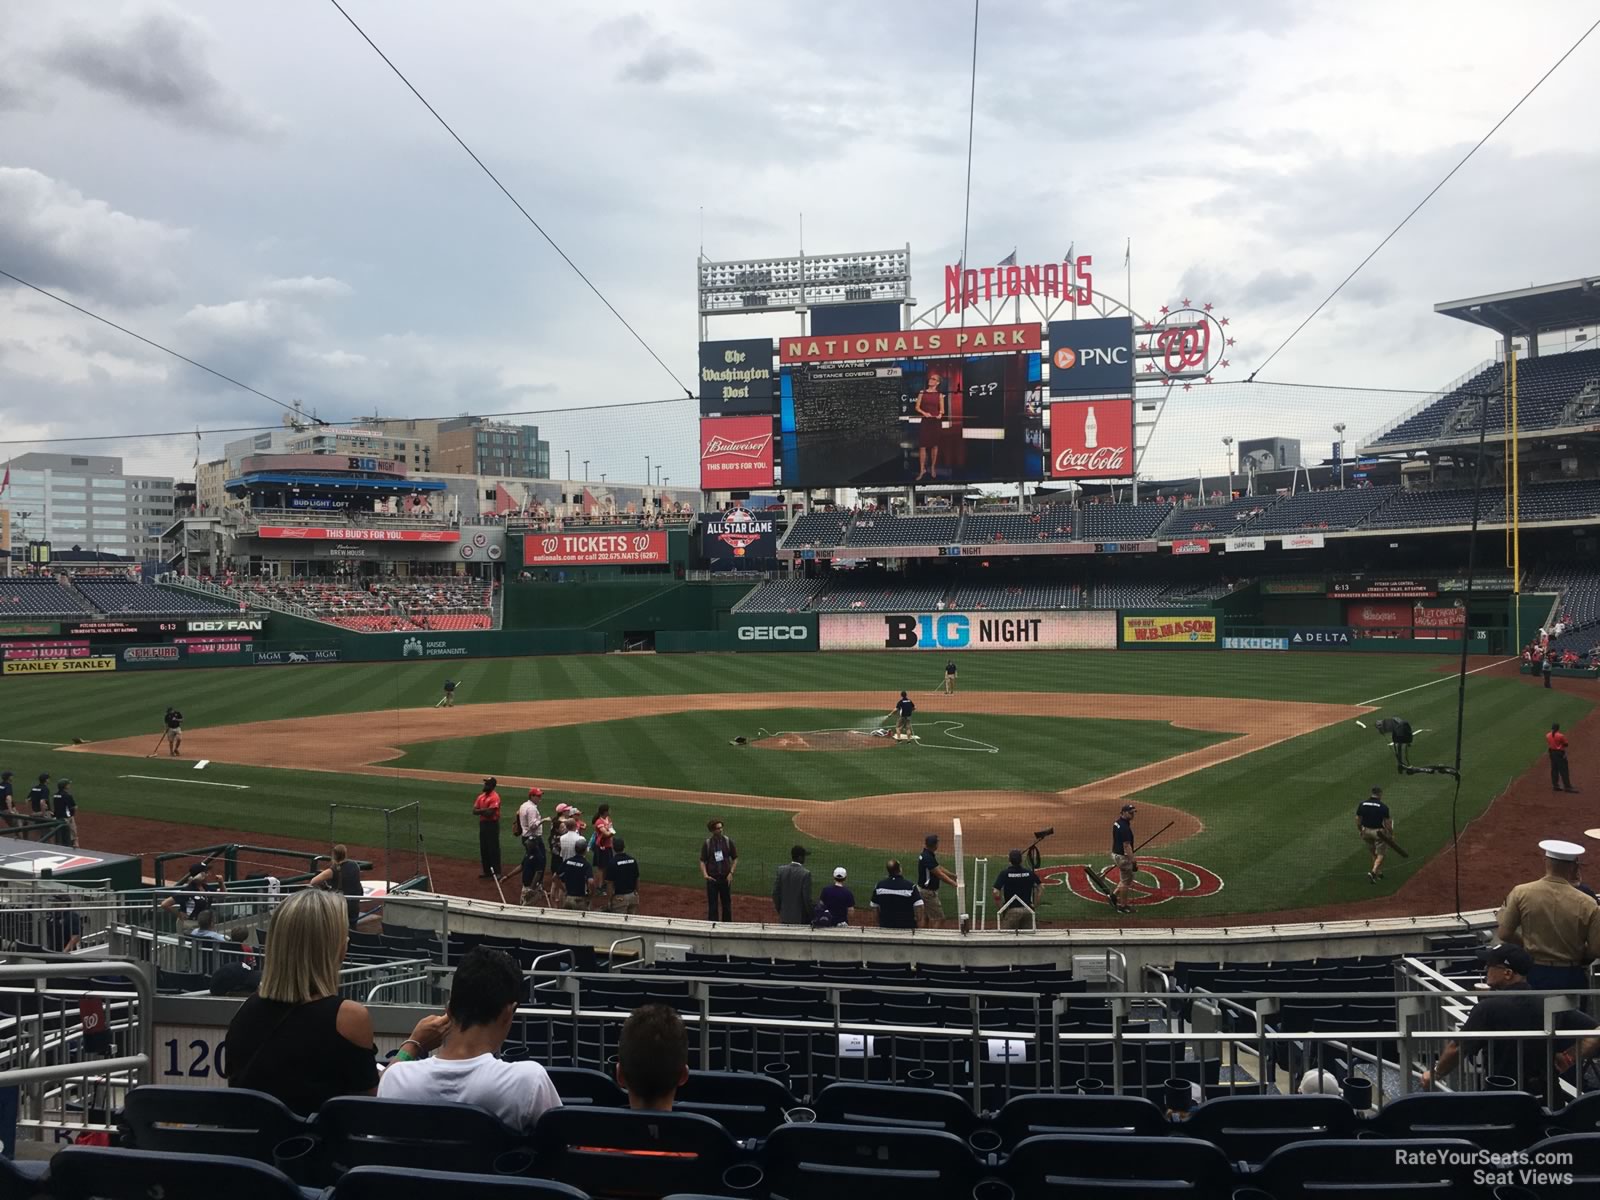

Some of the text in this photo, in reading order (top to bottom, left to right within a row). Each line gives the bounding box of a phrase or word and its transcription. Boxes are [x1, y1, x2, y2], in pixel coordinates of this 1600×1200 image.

[945, 255, 1092, 314] NATIONALS
[789, 329, 1025, 357] NATIONALS PARK
[724, 350, 746, 363] The
[1078, 346, 1128, 366] PNC
[702, 366, 770, 383] Washington
[722, 385, 749, 402] Post
[969, 382, 998, 397] FIP
[707, 441, 764, 453] Budweiser
[348, 457, 395, 472] BIG NIGHT
[1055, 446, 1128, 471] Coca-Cola
[707, 463, 720, 471] THIS
[748, 522, 772, 533] GAME
[326, 529, 403, 539] THIS BUD'S FOR YOU.
[563, 535, 627, 553] TICKETS
[1094, 543, 1140, 552] BIG NIGHT
[640, 551, 659, 560] (6287)
[794, 549, 834, 559] BIG NIGHT
[938, 547, 981, 556] BIG NIGHT
[160, 623, 176, 631] 6:13
[228, 620, 262, 631] FAN
[885, 614, 1042, 648] BIG NIGHT
[737, 625, 808, 640] GEICO
[1306, 632, 1348, 642] DELTA
[1476, 631, 1486, 639] 335
[1240, 637, 1283, 649] KOCH
[258, 652, 281, 660] MGM
[7, 660, 111, 672] STANLEY STANLEY
